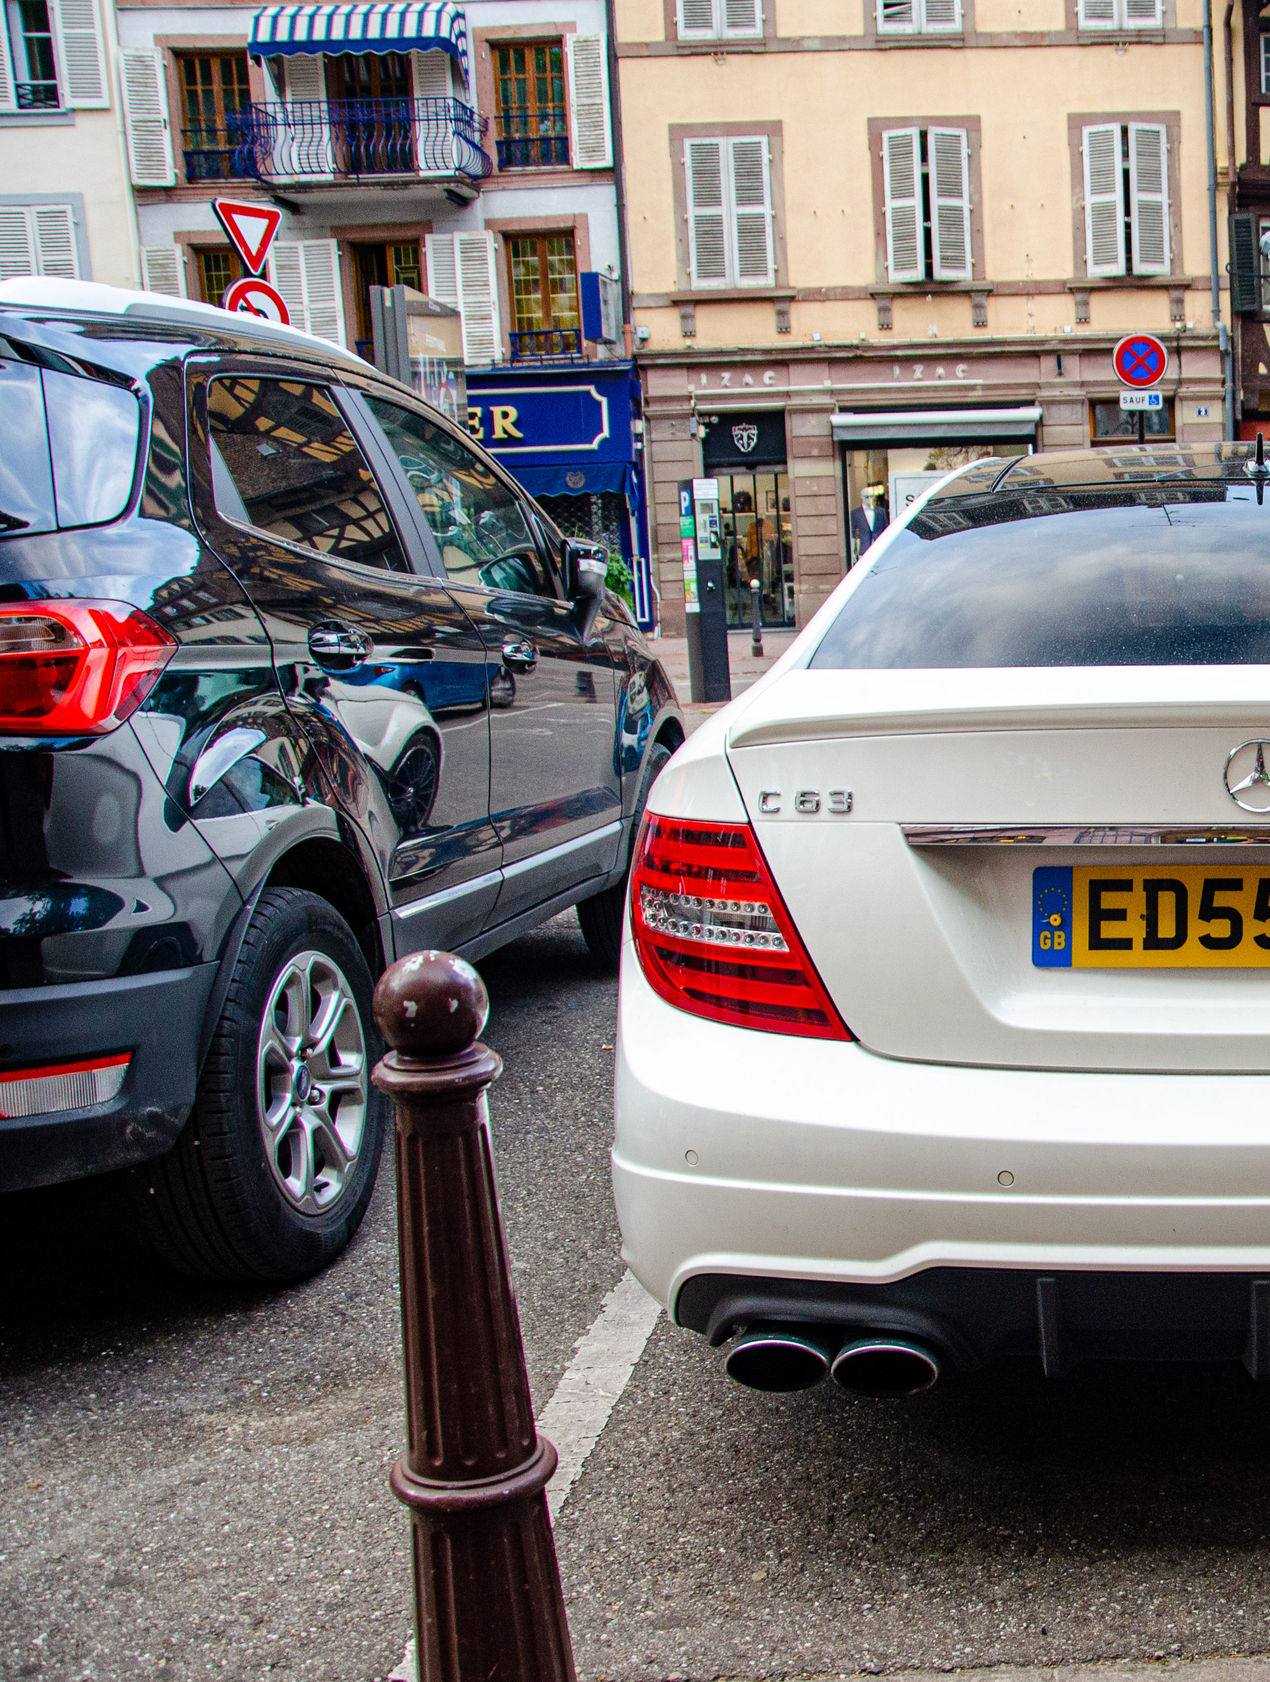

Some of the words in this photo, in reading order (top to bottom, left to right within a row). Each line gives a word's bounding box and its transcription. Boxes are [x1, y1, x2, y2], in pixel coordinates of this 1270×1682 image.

[700, 370, 776, 388] IZAC
[893, 363, 968, 381] IZAC
[1122, 396, 1146, 404] SAUF
[680, 490, 689, 515] P
[758, 789, 781, 813] C
[795, 788, 853, 813] 63
[1039, 930, 1066, 951] GB
